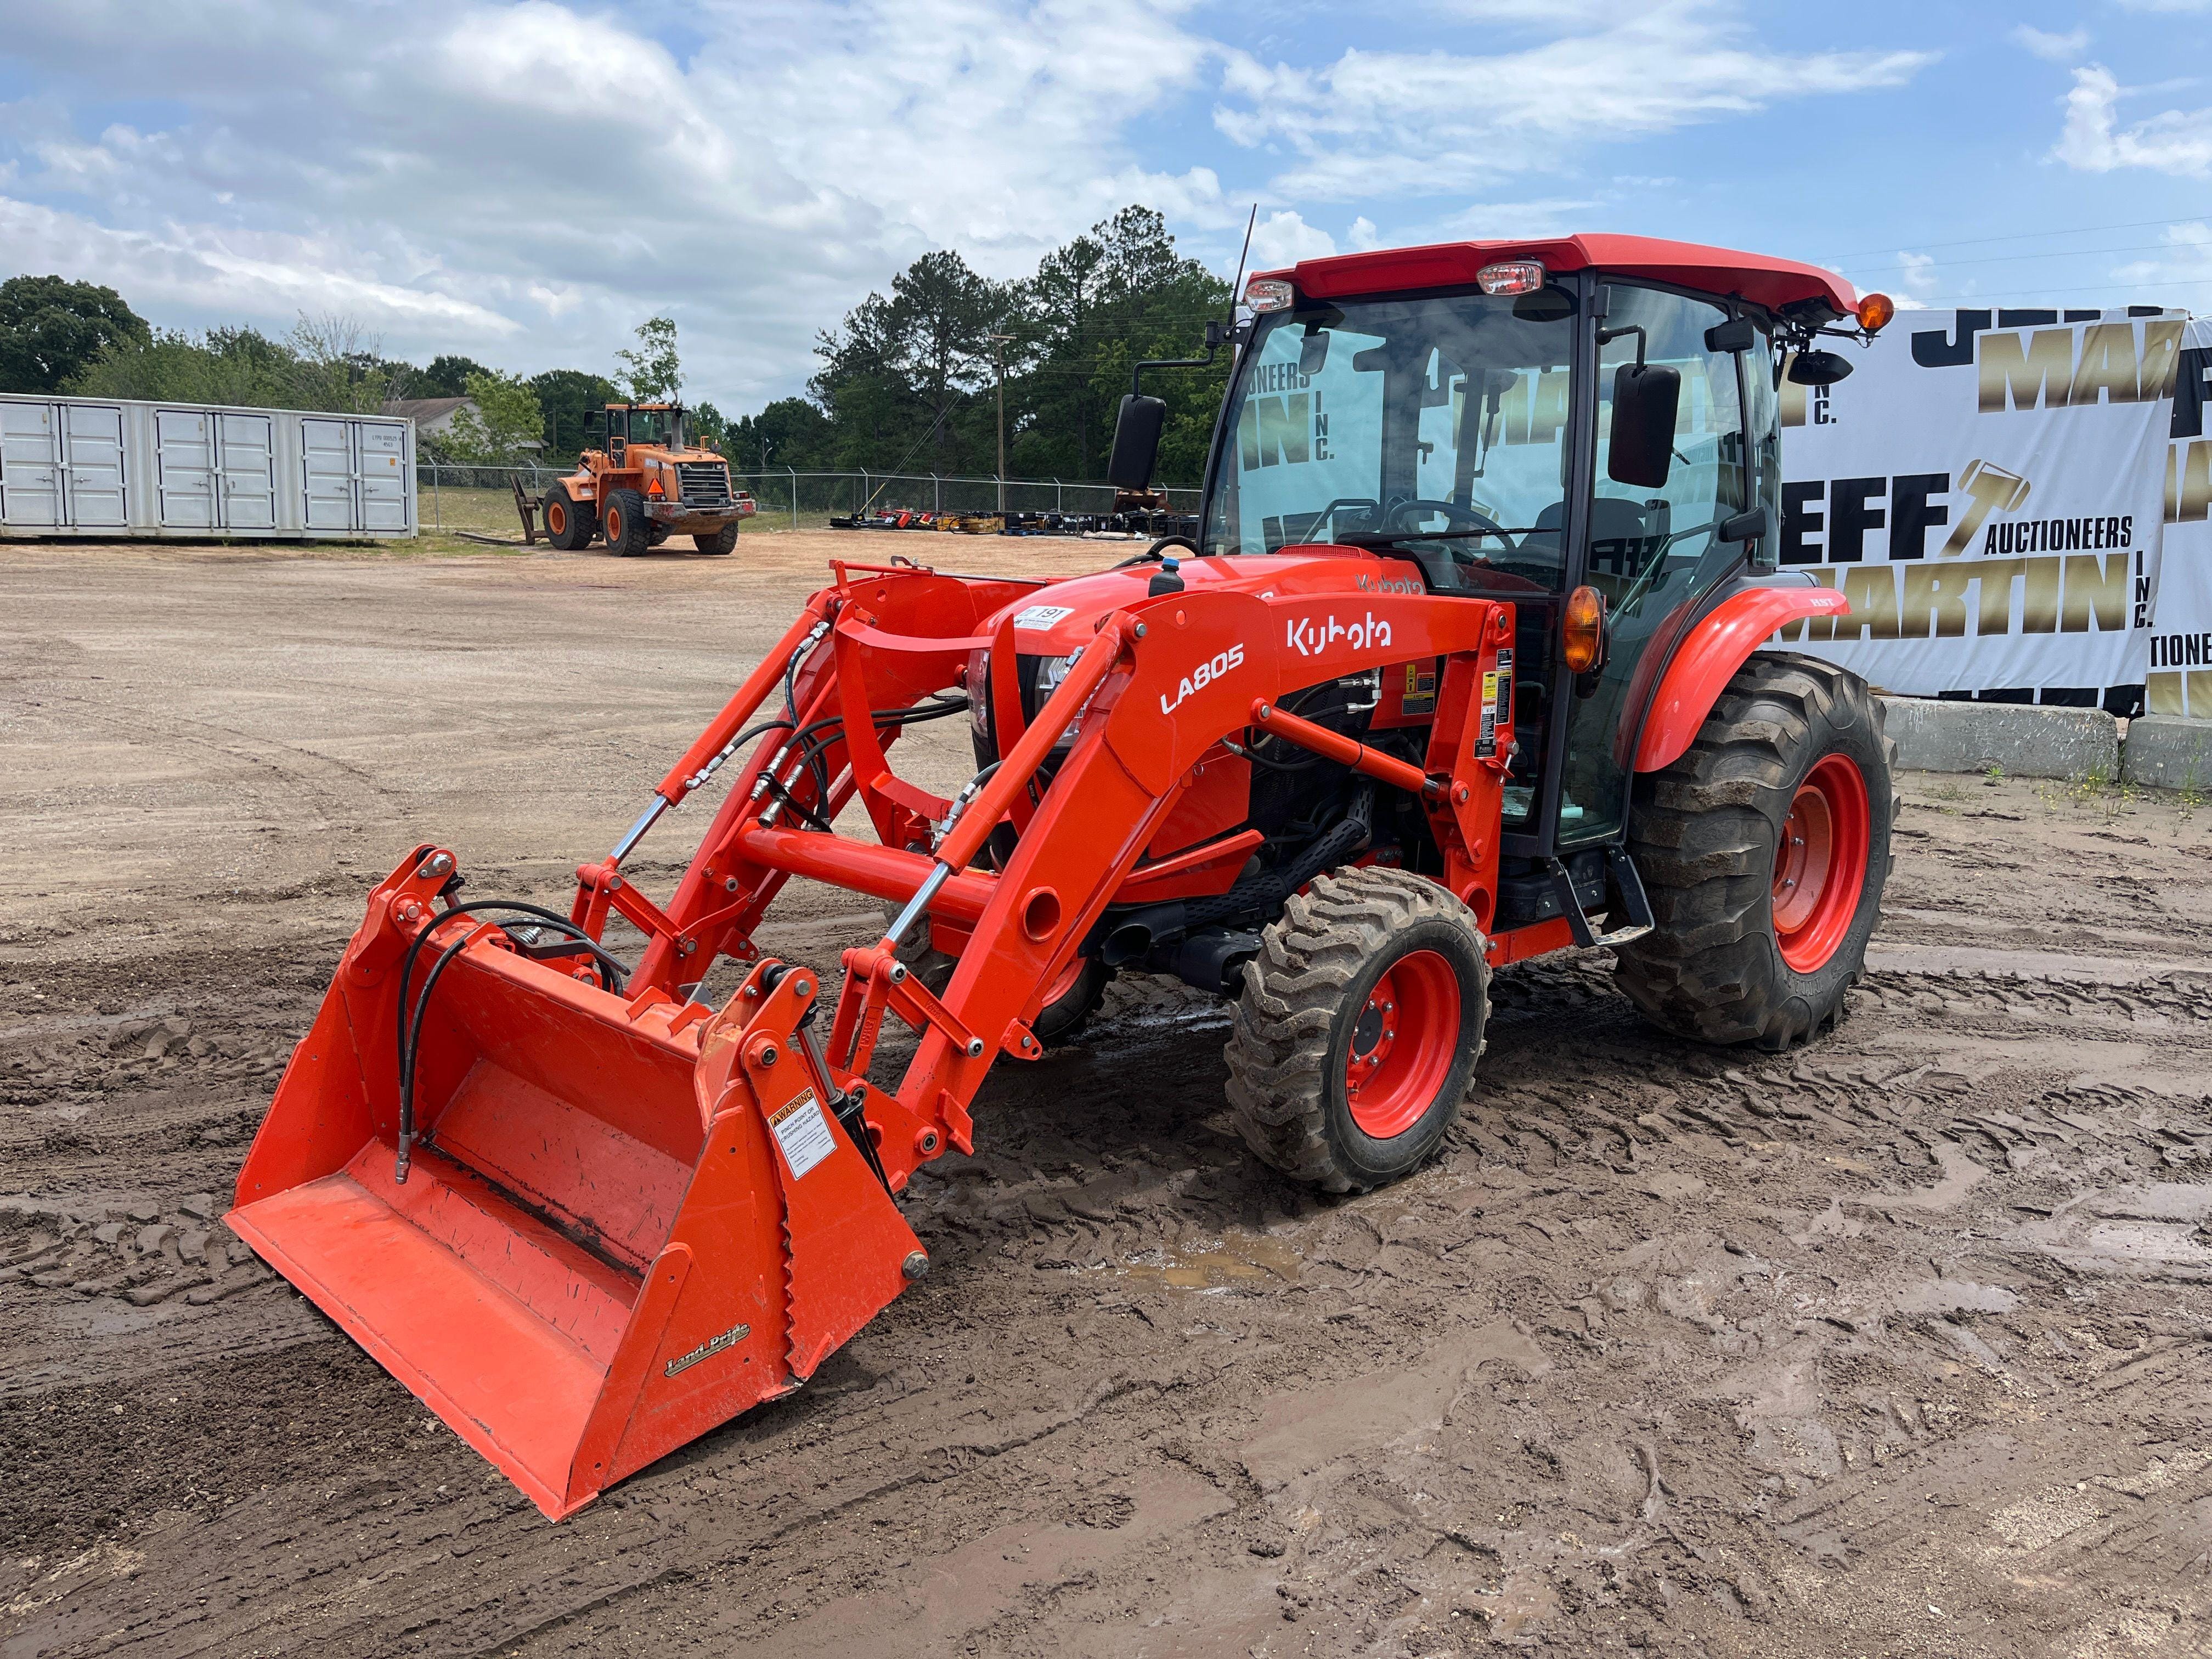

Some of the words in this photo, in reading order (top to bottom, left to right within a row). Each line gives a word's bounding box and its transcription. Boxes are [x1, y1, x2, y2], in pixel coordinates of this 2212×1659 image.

[1814, 385, 1836, 425] NC.
[1780, 473, 1949, 566] EFF
[1984, 516, 2132, 555] AUCTIONEERS
[1355, 574, 1425, 596] Kubota
[1809, 597, 1835, 607] HST
[2134, 550, 2155, 629] INC.
[1036, 608, 1066, 619] 191
[1287, 612, 1391, 656] Kubota
[1160, 643, 1244, 714] LA805
[778, 1089, 812, 1120] WARNING
[781, 1121, 794, 1135] PINCH
[795, 1112, 808, 1124] POINT
[807, 1107, 815, 1115] OR
[781, 1124, 803, 1143] CRUSHING
[803, 1110, 820, 1126] HAZARD
[667, 1342, 705, 1373] Land
[709, 1323, 750, 1351] Pride
